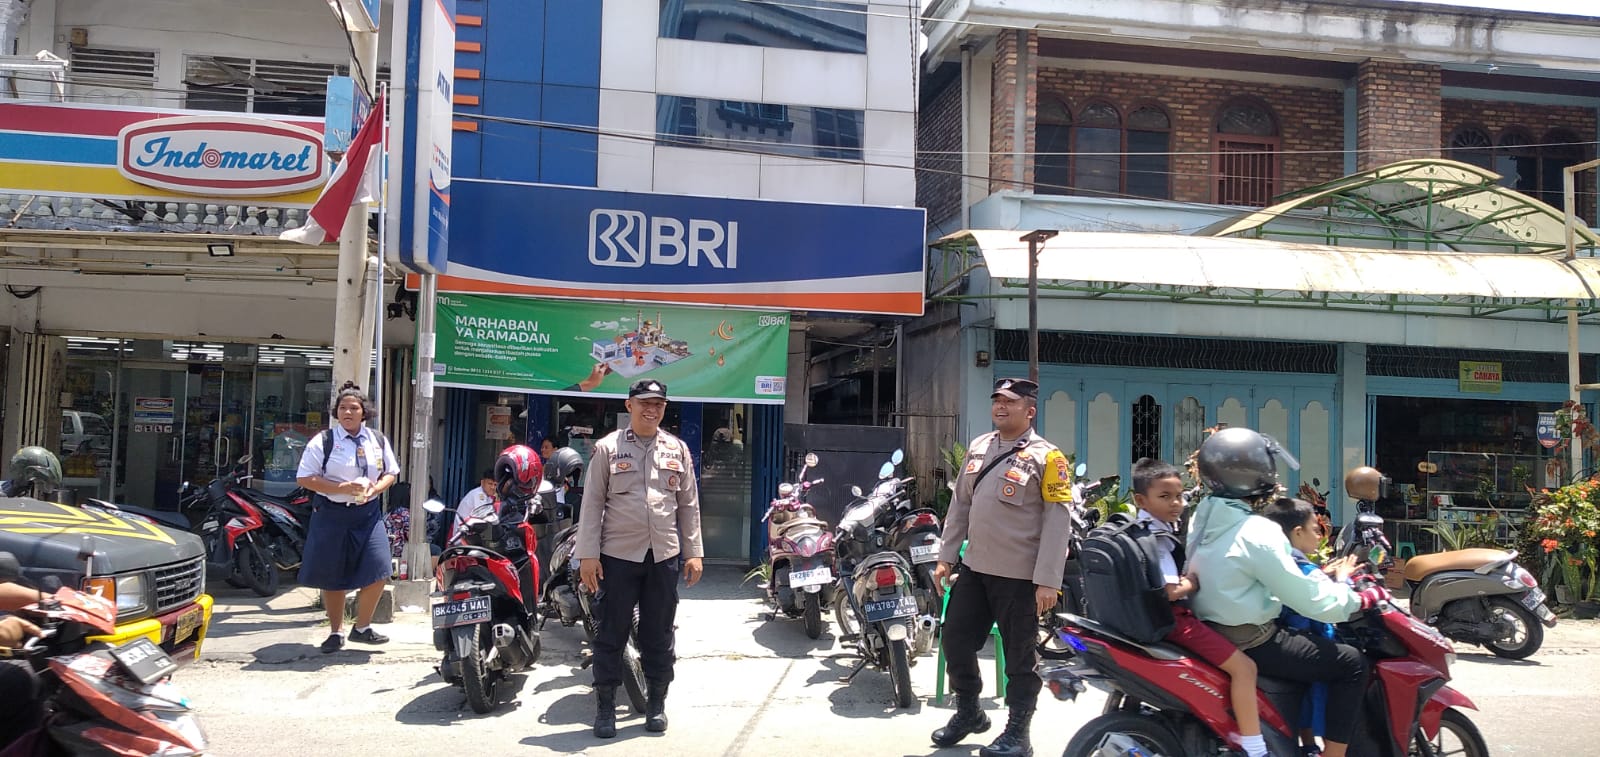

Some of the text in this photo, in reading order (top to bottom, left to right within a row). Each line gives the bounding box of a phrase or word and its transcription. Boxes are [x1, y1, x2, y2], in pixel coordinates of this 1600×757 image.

[437, 70, 450, 104] ATM
[136, 136, 312, 172] Indomaret
[650, 216, 738, 269] BRI
[455, 315, 539, 332] MARHABAN
[770, 316, 787, 326] BRI
[455, 326, 551, 345] YA RAMADAN
[469, 600, 488, 610] WAL
